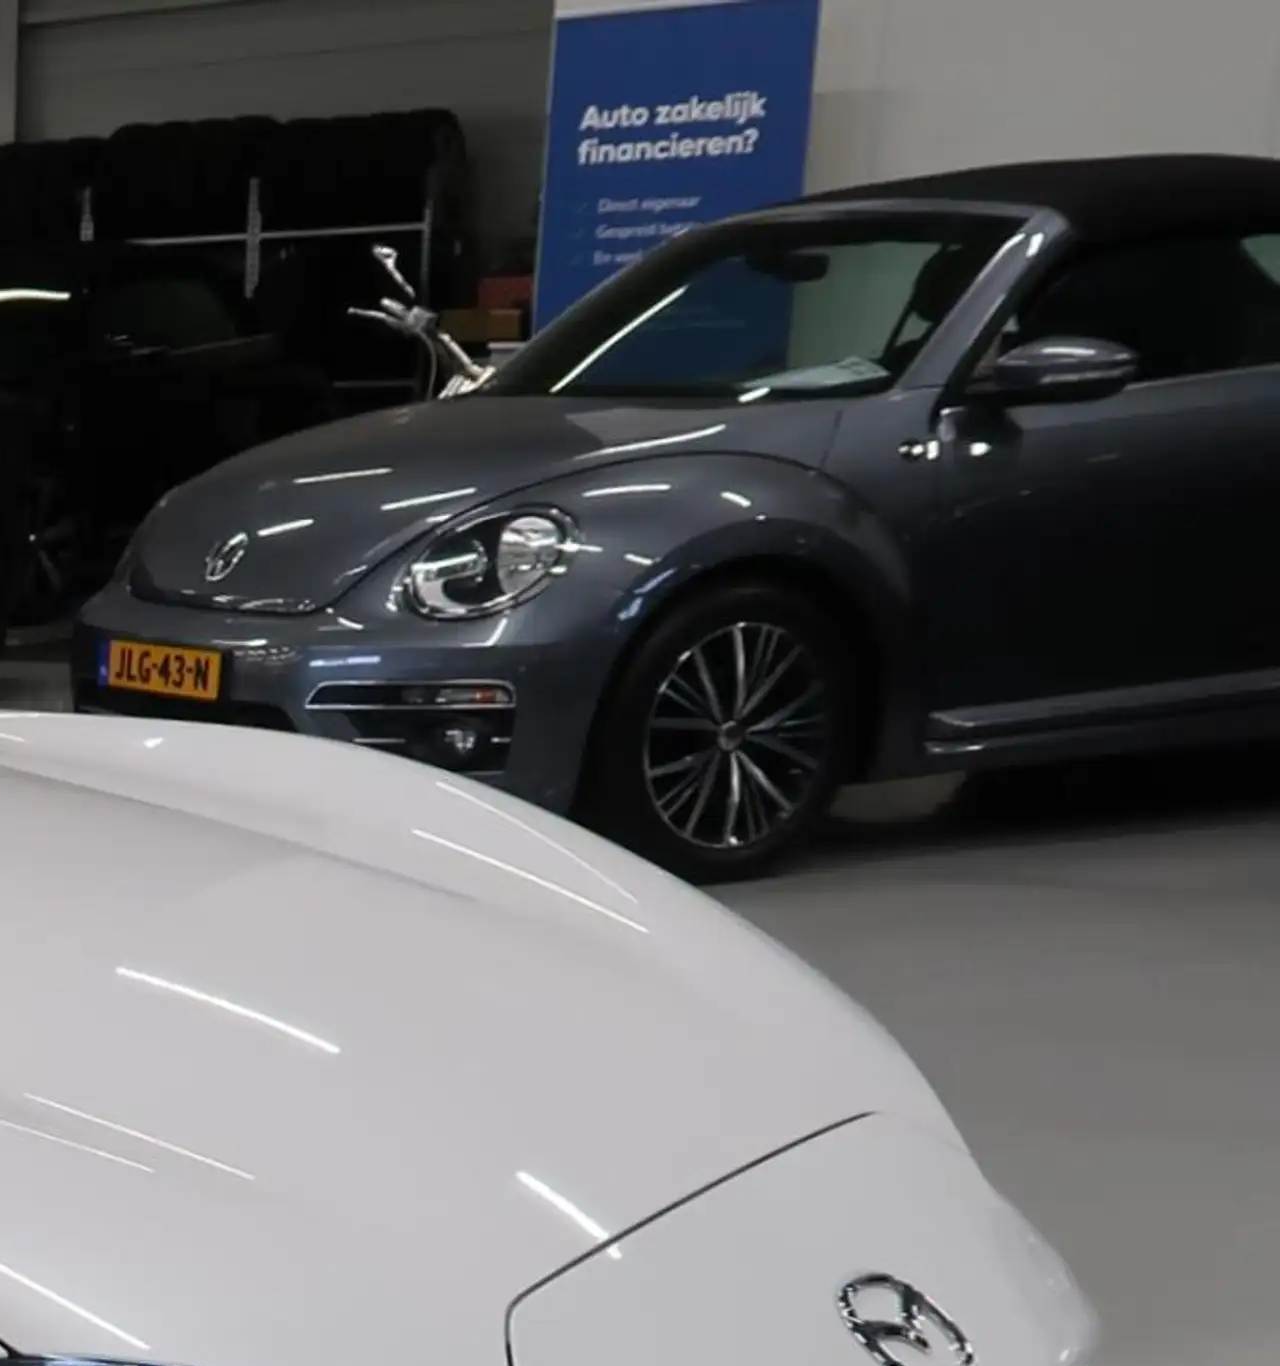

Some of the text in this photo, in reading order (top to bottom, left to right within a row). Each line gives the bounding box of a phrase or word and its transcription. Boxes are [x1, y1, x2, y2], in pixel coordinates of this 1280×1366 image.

[578, 90, 767, 131] Auto zakelijk
[577, 128, 759, 165] financieren?
[115, 648, 210, 692] JLG-43-N
